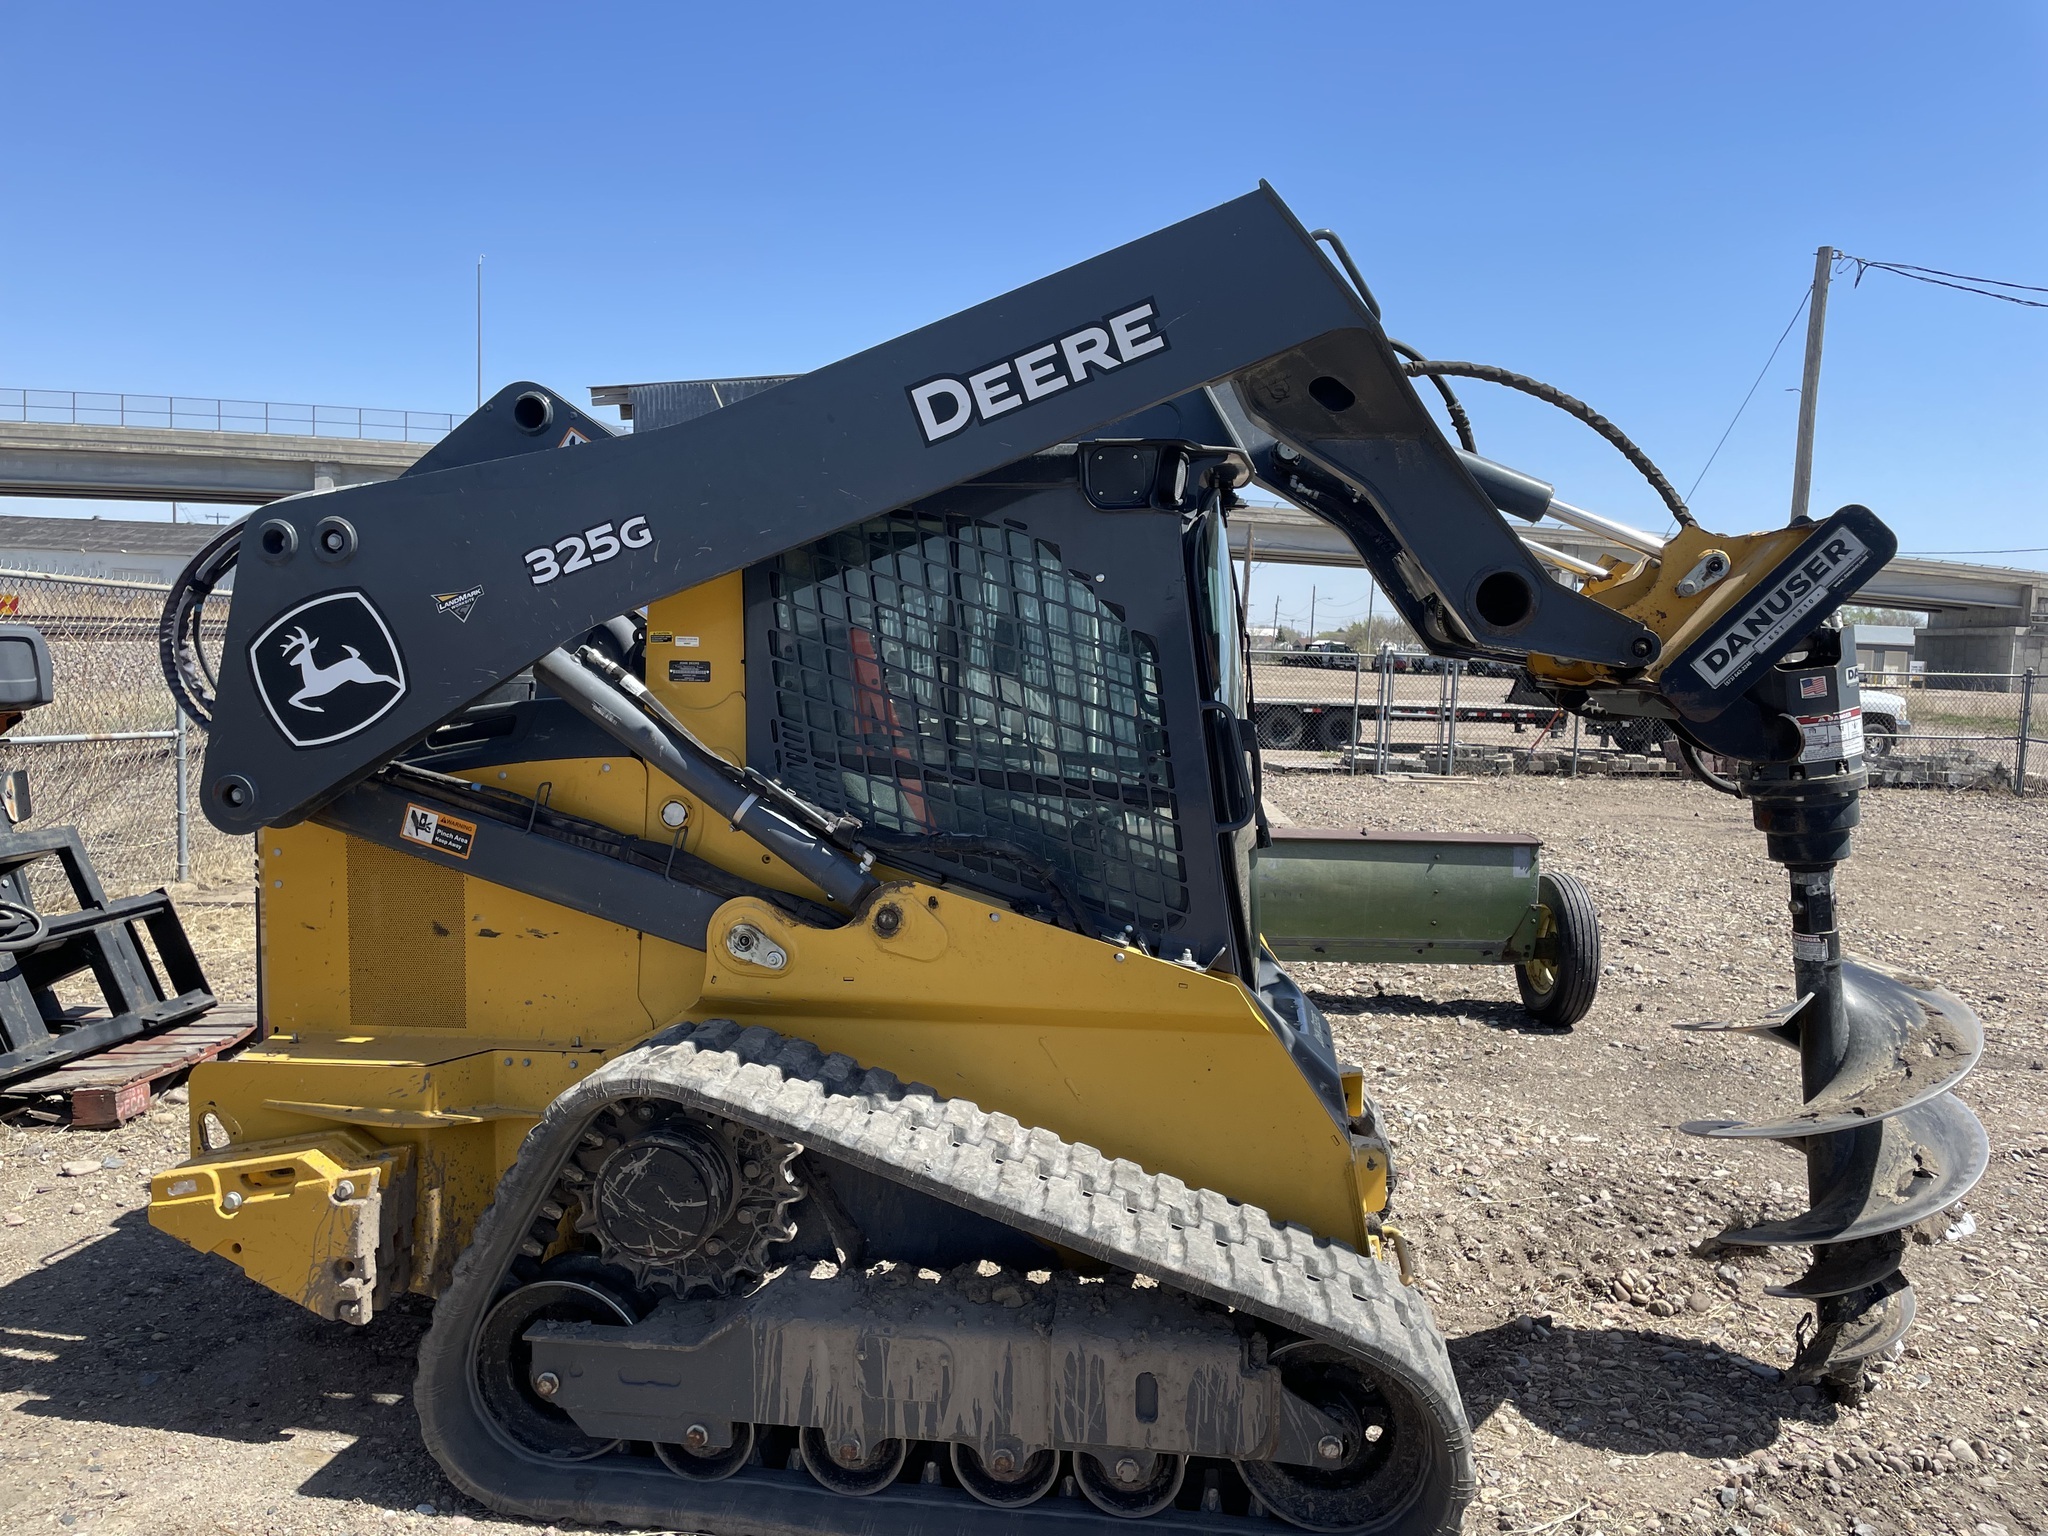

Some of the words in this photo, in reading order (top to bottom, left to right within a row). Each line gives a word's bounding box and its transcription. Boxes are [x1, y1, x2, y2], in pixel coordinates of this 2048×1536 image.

[911, 303, 1165, 442] DEERE
[524, 515, 653, 585] 325G
[440, 589, 481, 609] LANDMARK
[1702, 538, 1853, 674] DANUSER
[1792, 598, 1814, 619] 1910
[446, 819, 473, 832] WARNING
[434, 836, 447, 845] Keep
[448, 841, 462, 850] Away
[437, 828, 453, 839] Pinch
[454, 834, 468, 844] Area
